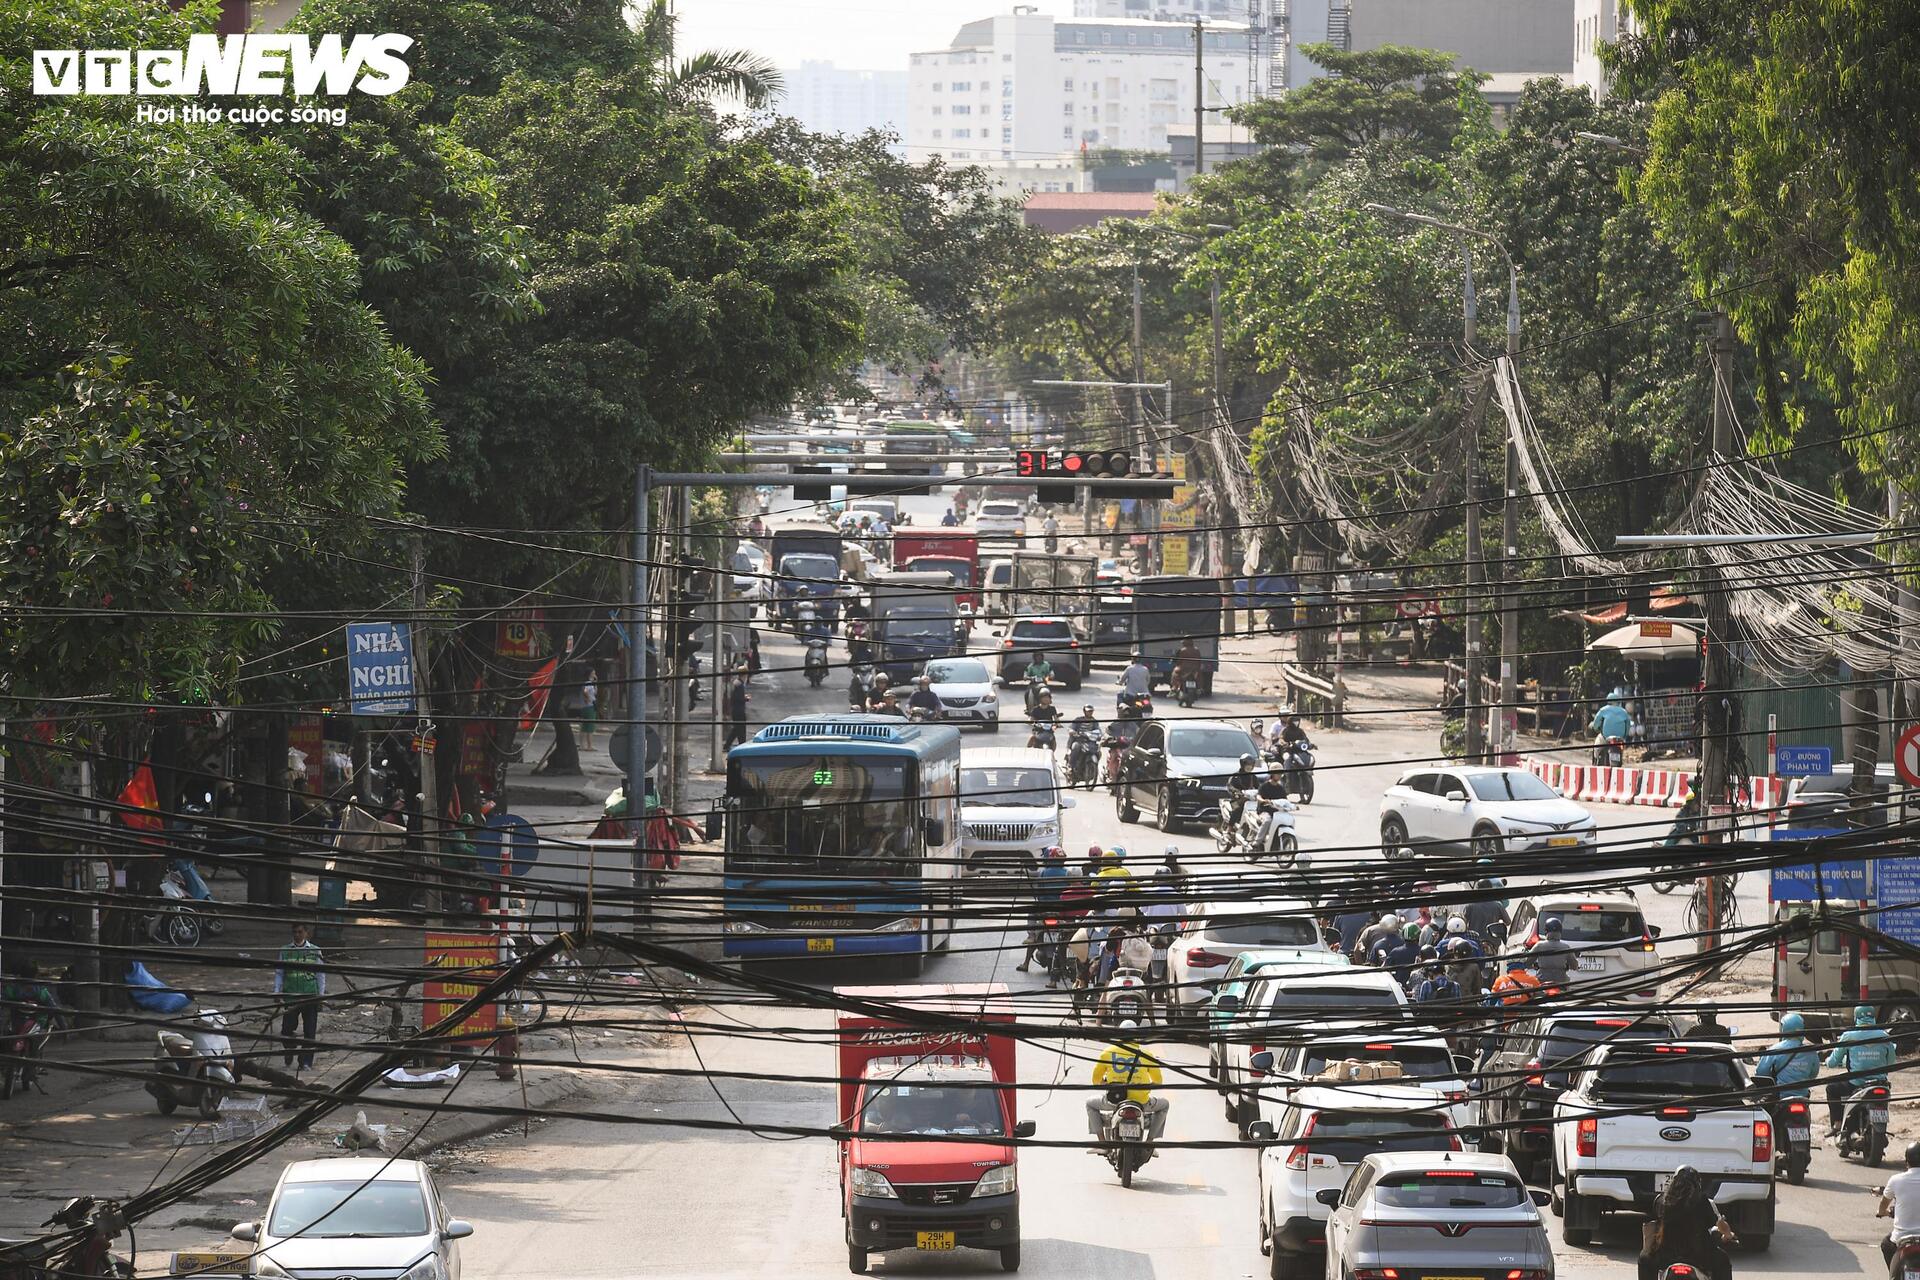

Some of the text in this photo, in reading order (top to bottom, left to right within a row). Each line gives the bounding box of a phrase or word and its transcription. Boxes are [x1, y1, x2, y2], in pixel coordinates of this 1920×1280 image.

[1020, 452, 1046, 475] 31
[354, 627, 404, 653] NHÀ
[508, 624, 526, 640] 18
[353, 656, 410, 687] NGHỈ
[927, 1232, 944, 1241] 29H
